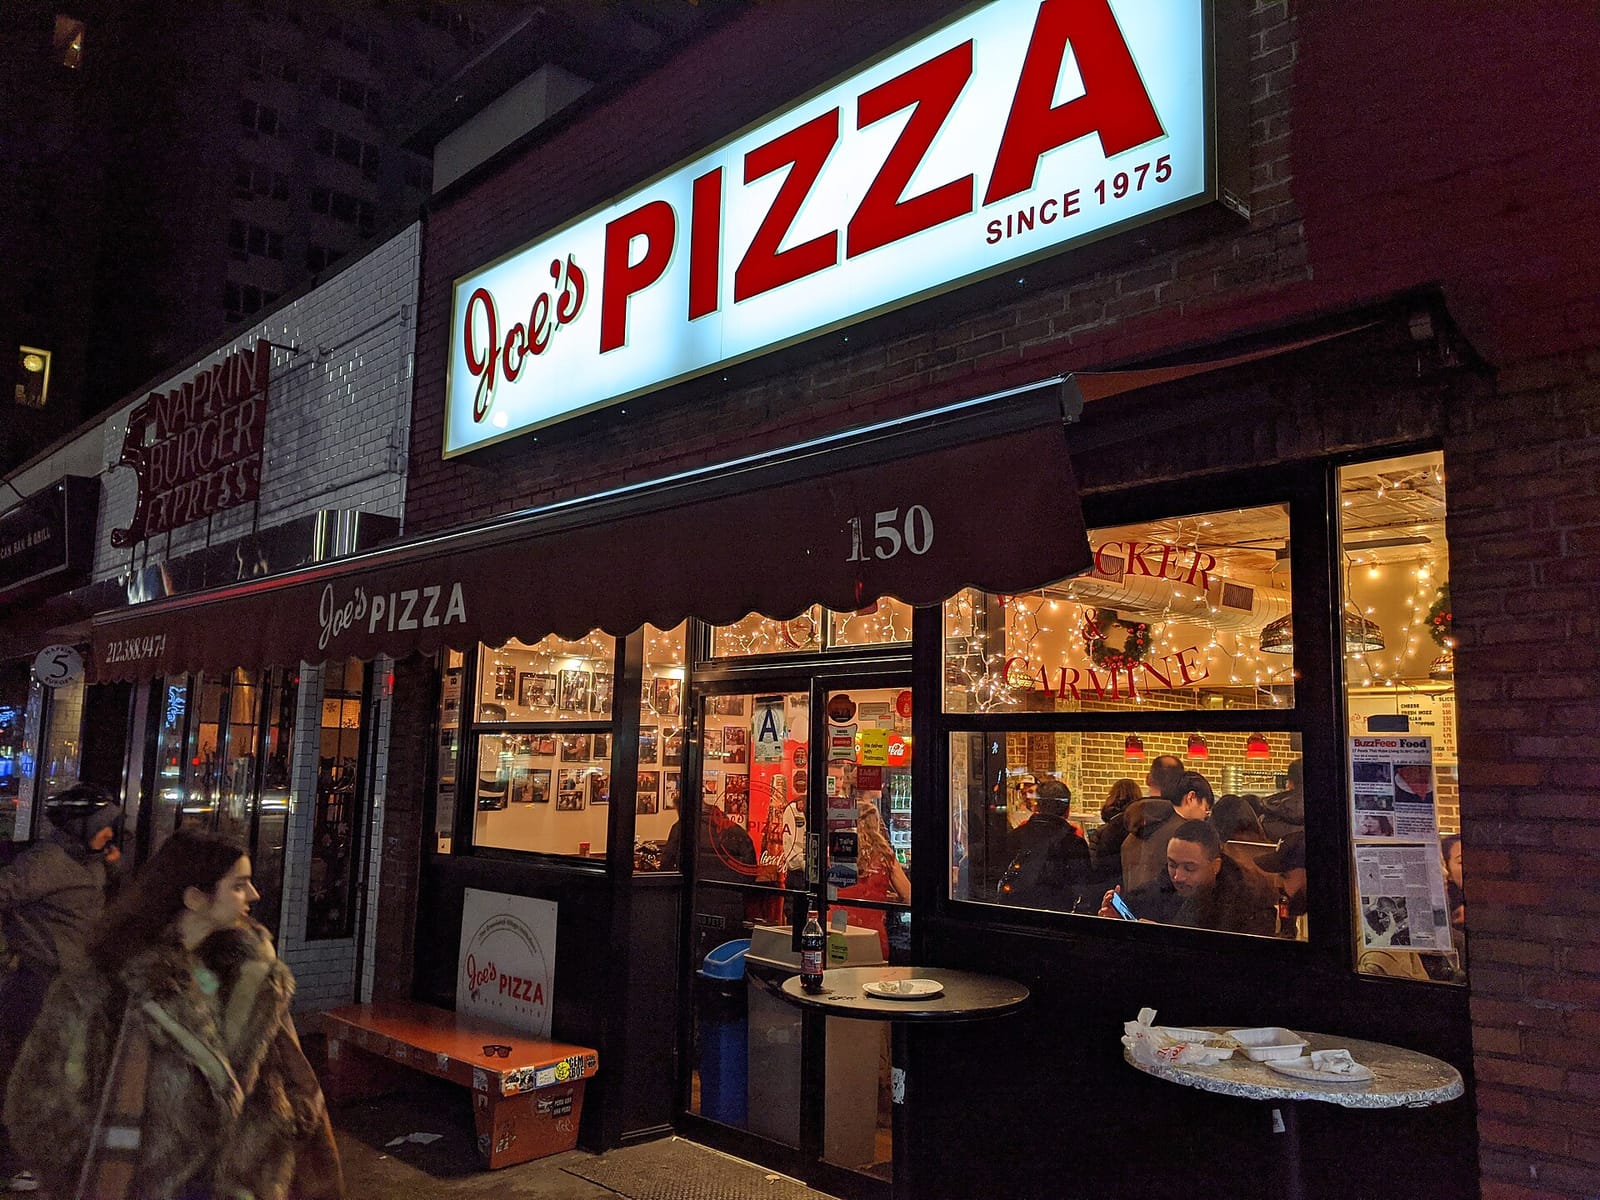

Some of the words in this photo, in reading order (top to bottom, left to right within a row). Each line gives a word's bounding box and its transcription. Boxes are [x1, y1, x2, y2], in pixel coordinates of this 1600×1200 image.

[464, 253, 588, 423] Joe's
[599, 0, 1168, 355] PIZZA
[986, 189, 1080, 245] SINCE
[1094, 154, 1172, 205] 1975
[155, 340, 259, 438] NAPKIN
[149, 400, 257, 492] BURGER
[144, 459, 251, 537] EXPRESS
[845, 504, 935, 562] 150
[318, 582, 367, 651] Joe's
[368, 582, 467, 634] PIZZA
[1082, 608, 1108, 641] &
[52, 654, 68, 678] 5
[1002, 646, 1210, 700] CARMINE
[758, 709, 779, 742] A
[1399, 738, 1427, 748] Food
[749, 821, 792, 836] PIZZA
[467, 954, 497, 991] Joe's
[499, 973, 544, 1006] PIZZA
